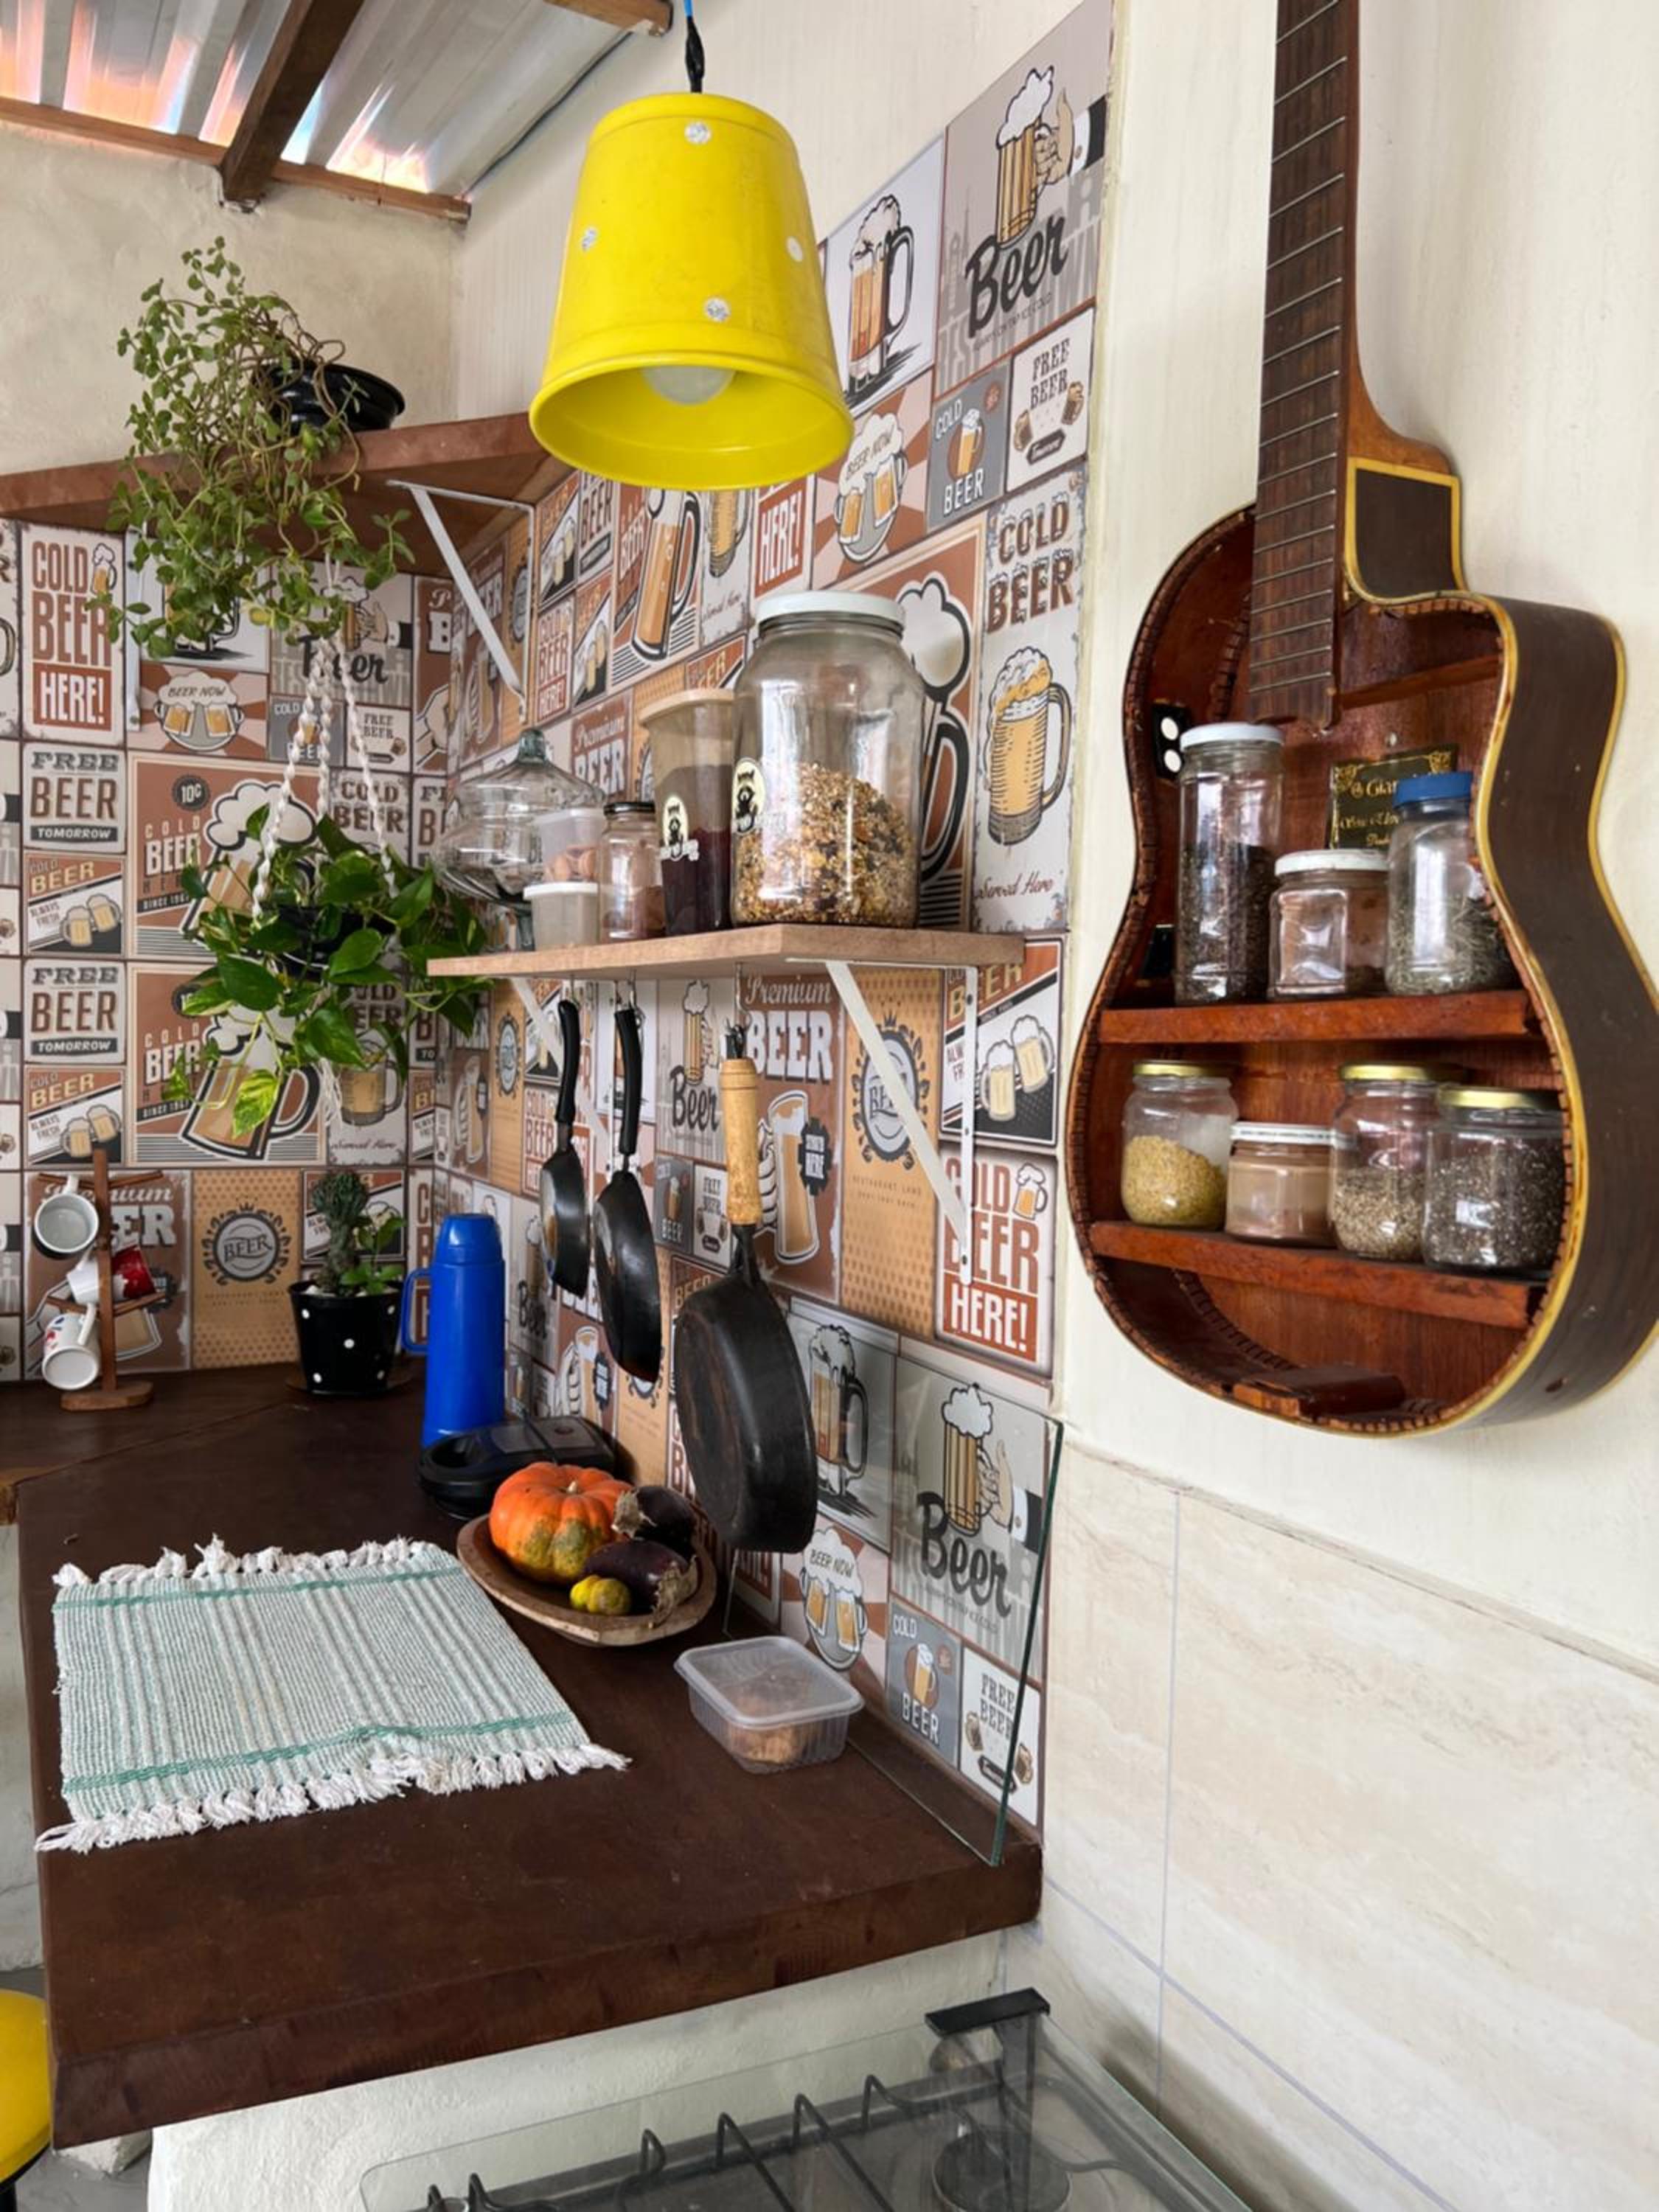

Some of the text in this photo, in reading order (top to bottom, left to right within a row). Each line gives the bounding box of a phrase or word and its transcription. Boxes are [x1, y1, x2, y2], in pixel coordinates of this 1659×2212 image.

[965, 215, 1068, 338] Beer
[1033, 338, 1069, 381] FREE
[1030, 368, 1068, 409] BEER
[936, 399, 962, 440] COLD
[944, 467, 984, 516] BEER
[759, 490, 802, 585] HERE!
[998, 493, 1069, 564] COLD
[32, 540, 88, 594] COLD
[987, 551, 1074, 634] BEER
[32, 591, 111, 665] BEER
[41, 670, 105, 724] HERE!
[167, 686, 198, 698] BEER
[31, 751, 119, 771] FREE
[30, 776, 116, 820] BEER
[37, 827, 111, 839] TOMORROW
[145, 815, 201, 839] COLD
[145, 832, 201, 877] BEER
[32, 860, 95, 895] BEER
[32, 967, 119, 985] FREE
[745, 973, 832, 1005] Premium
[950, 961, 1023, 1021] BER
[31, 990, 116, 1033] BEER
[37, 1040, 111, 1052] TOMORROW
[746, 1011, 833, 1082] BEER
[32, 1073, 95, 1108] BEER
[669, 1065, 719, 1133] Beer
[945, 1157, 1011, 1214] CLD
[223, 1236, 273, 1263] BEER
[951, 1282, 1029, 1352] HERE!
[917, 1491, 1012, 1618] Beer
[893, 1613, 917, 1639] COLD
[981, 1673, 1016, 1714] FREE
[901, 1692, 940, 1747] BEER
